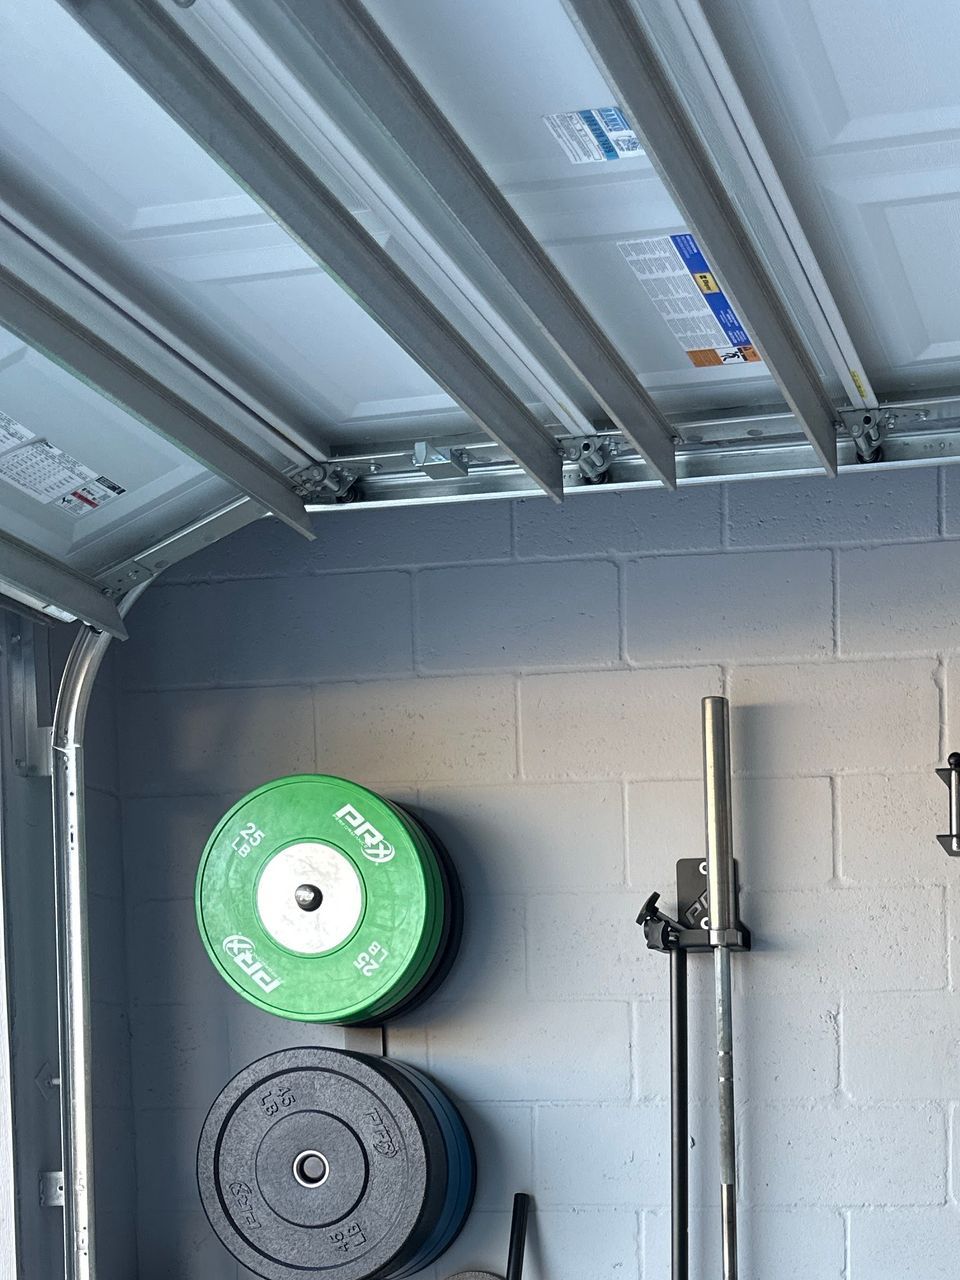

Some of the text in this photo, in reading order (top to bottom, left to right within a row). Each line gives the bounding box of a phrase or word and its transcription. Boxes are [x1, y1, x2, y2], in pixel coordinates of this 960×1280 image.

[240, 822, 265, 847] 25
[231, 840, 251, 859] LB
[368, 940, 389, 961] LB
[353, 952, 380, 977] 25
